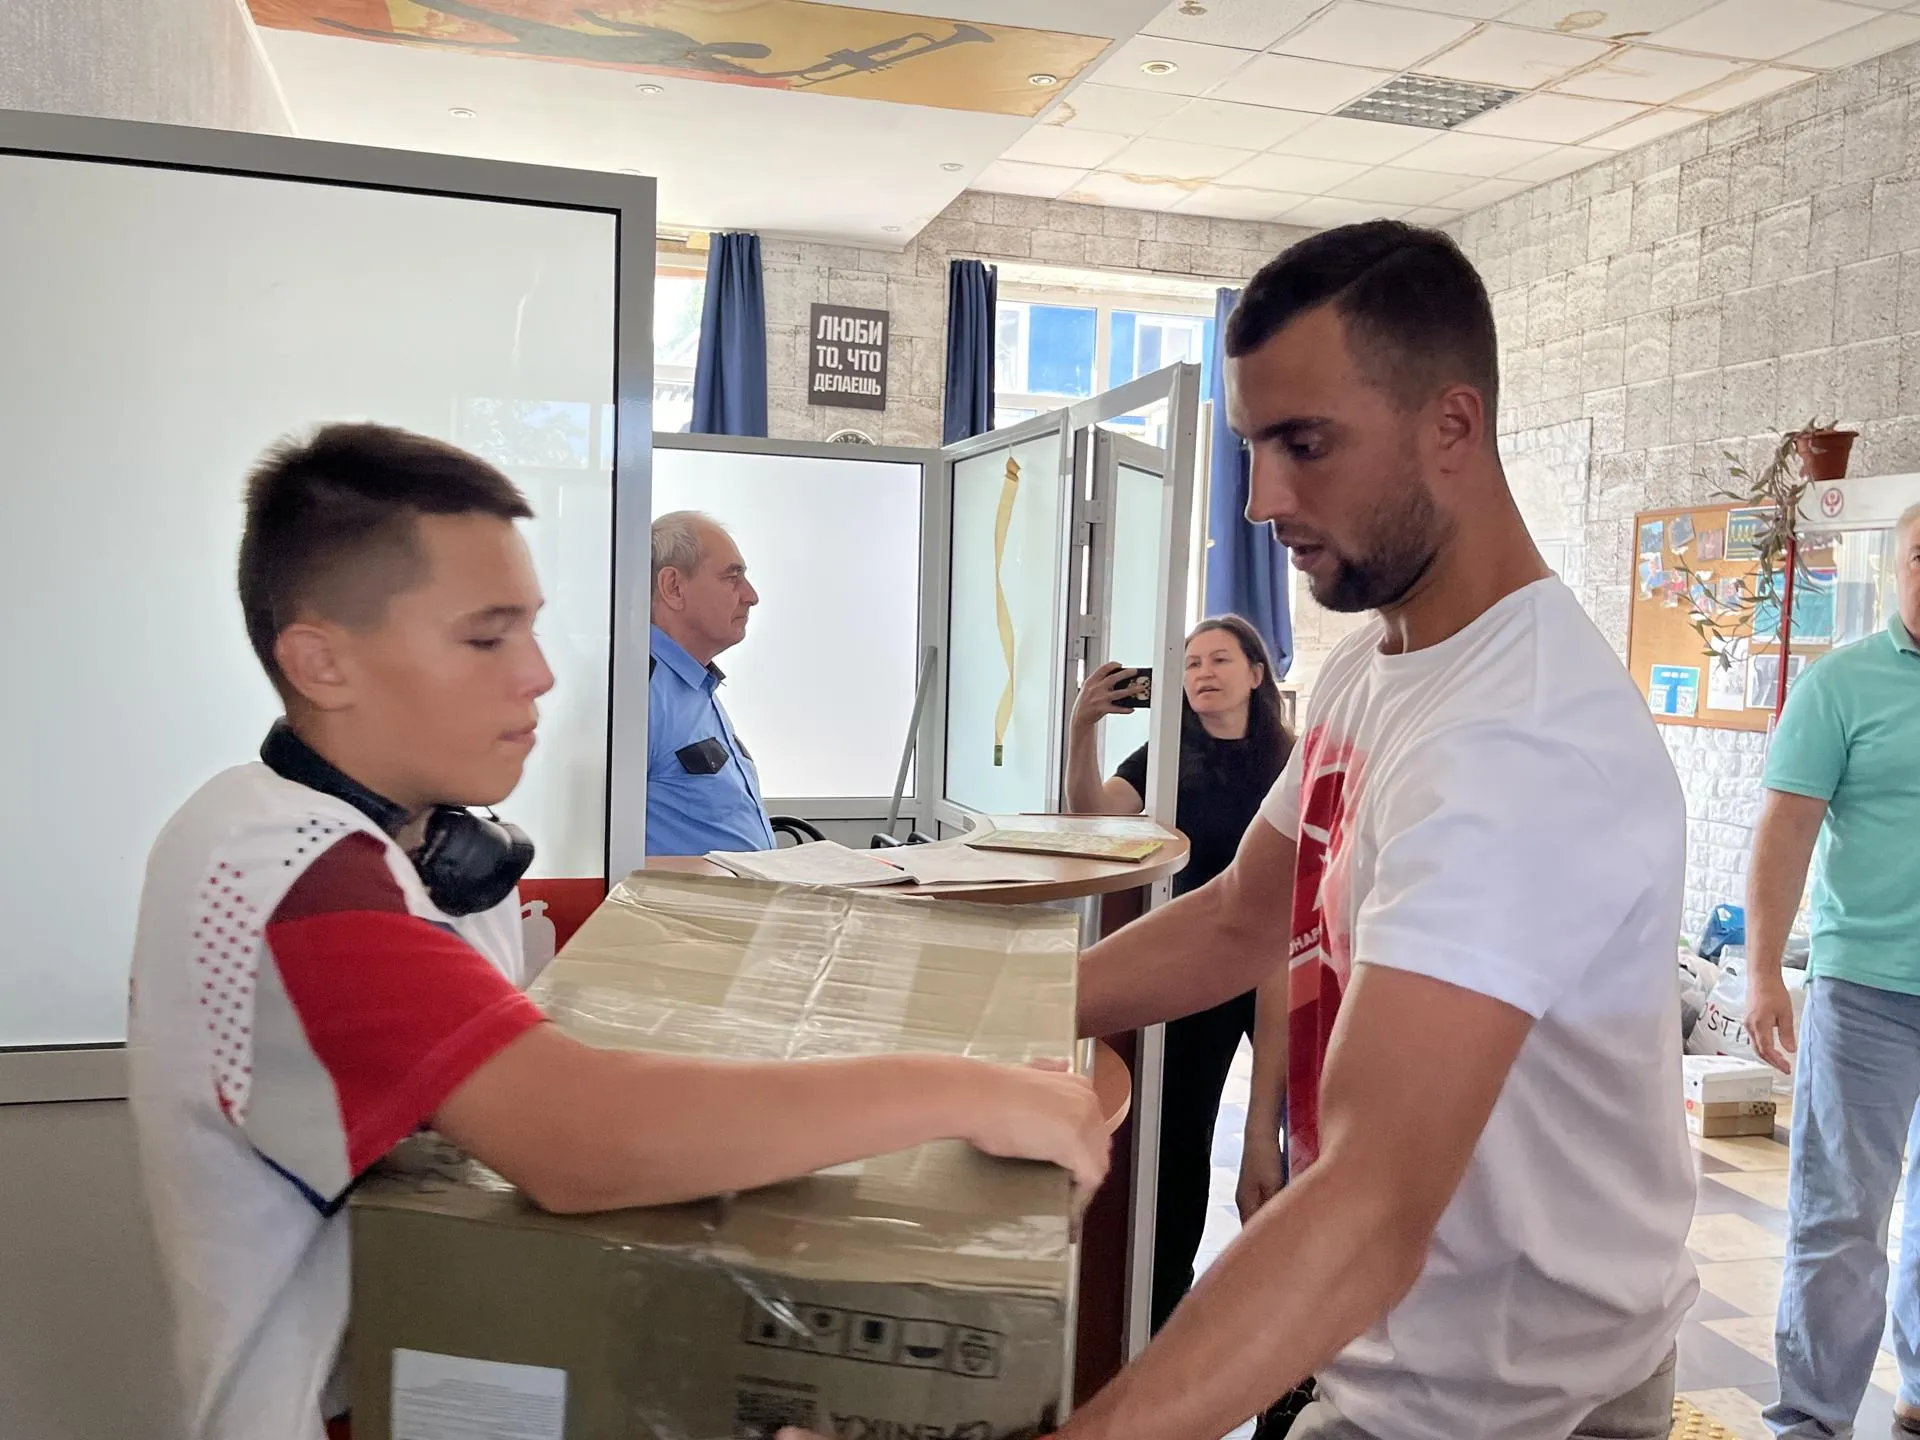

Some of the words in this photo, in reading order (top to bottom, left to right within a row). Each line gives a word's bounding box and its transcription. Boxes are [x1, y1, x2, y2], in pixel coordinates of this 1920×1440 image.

[816, 315, 884, 346] ЛЮБИ
[816, 345, 844, 371] ТО,
[847, 348, 882, 373] ЧТО
[813, 373, 882, 396] ДЕЛАЕШЬ
